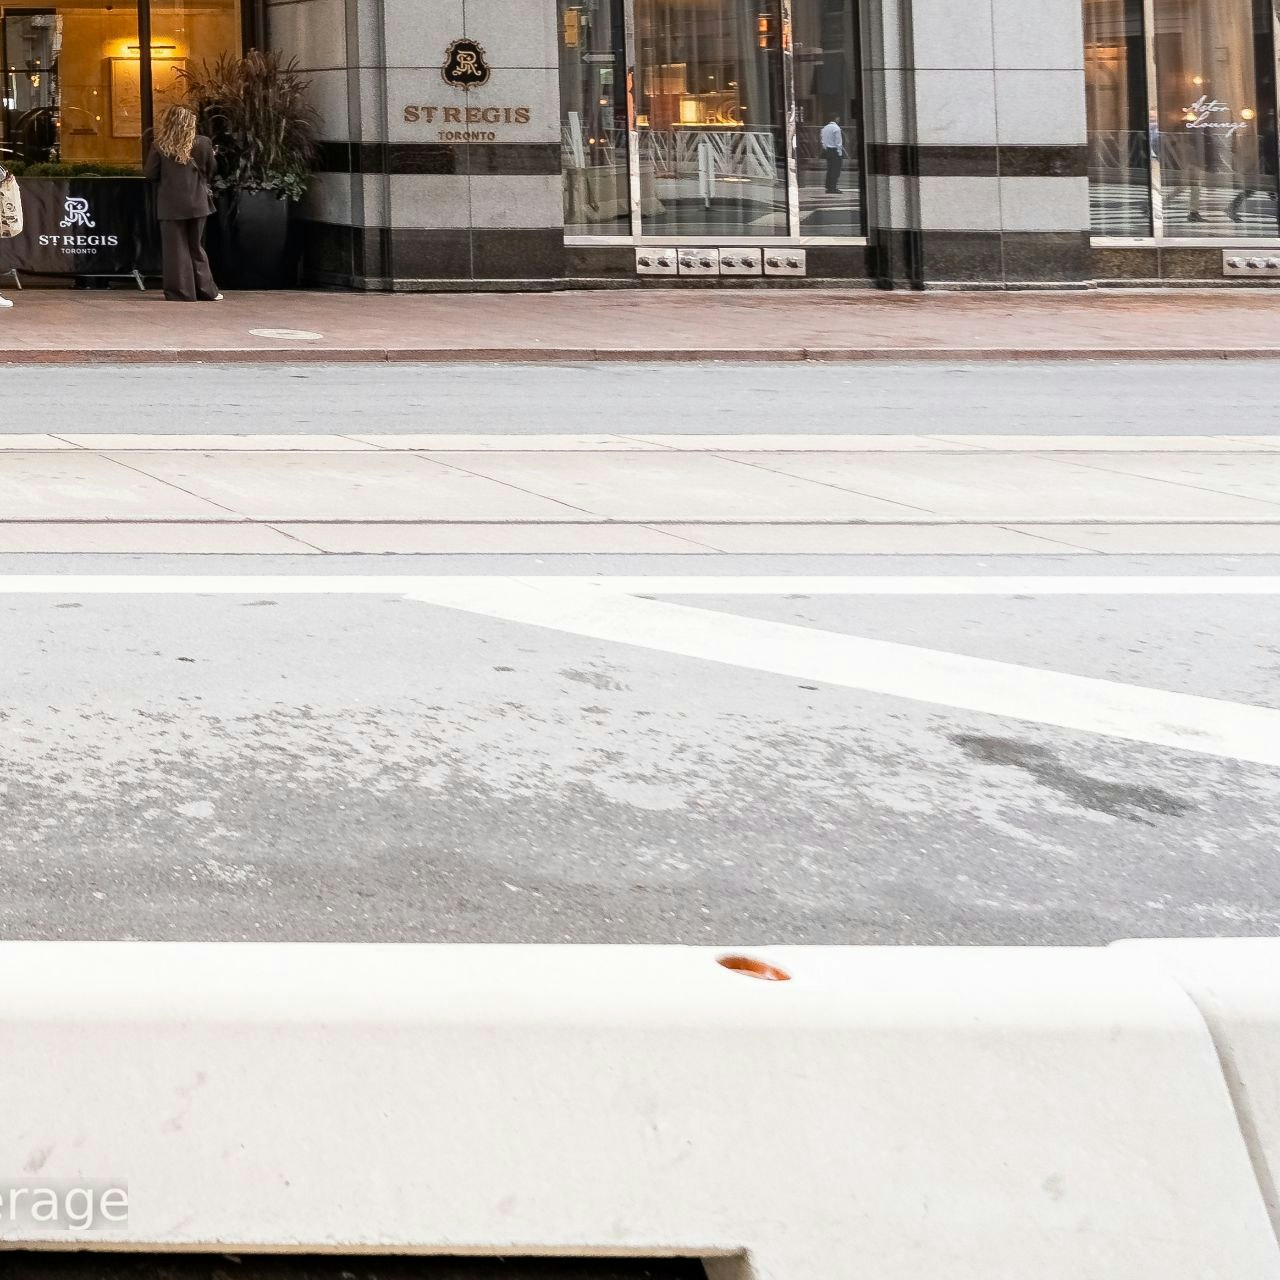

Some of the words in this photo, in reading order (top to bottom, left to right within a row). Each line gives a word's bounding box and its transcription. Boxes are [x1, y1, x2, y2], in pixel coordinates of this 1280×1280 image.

[1182, 95, 1230, 112] Astor
[443, 106, 531, 124] REGIS
[1186, 111, 1248, 138] Lounge
[438, 131, 496, 141] TORONTO
[63, 234, 118, 246] REGIS
